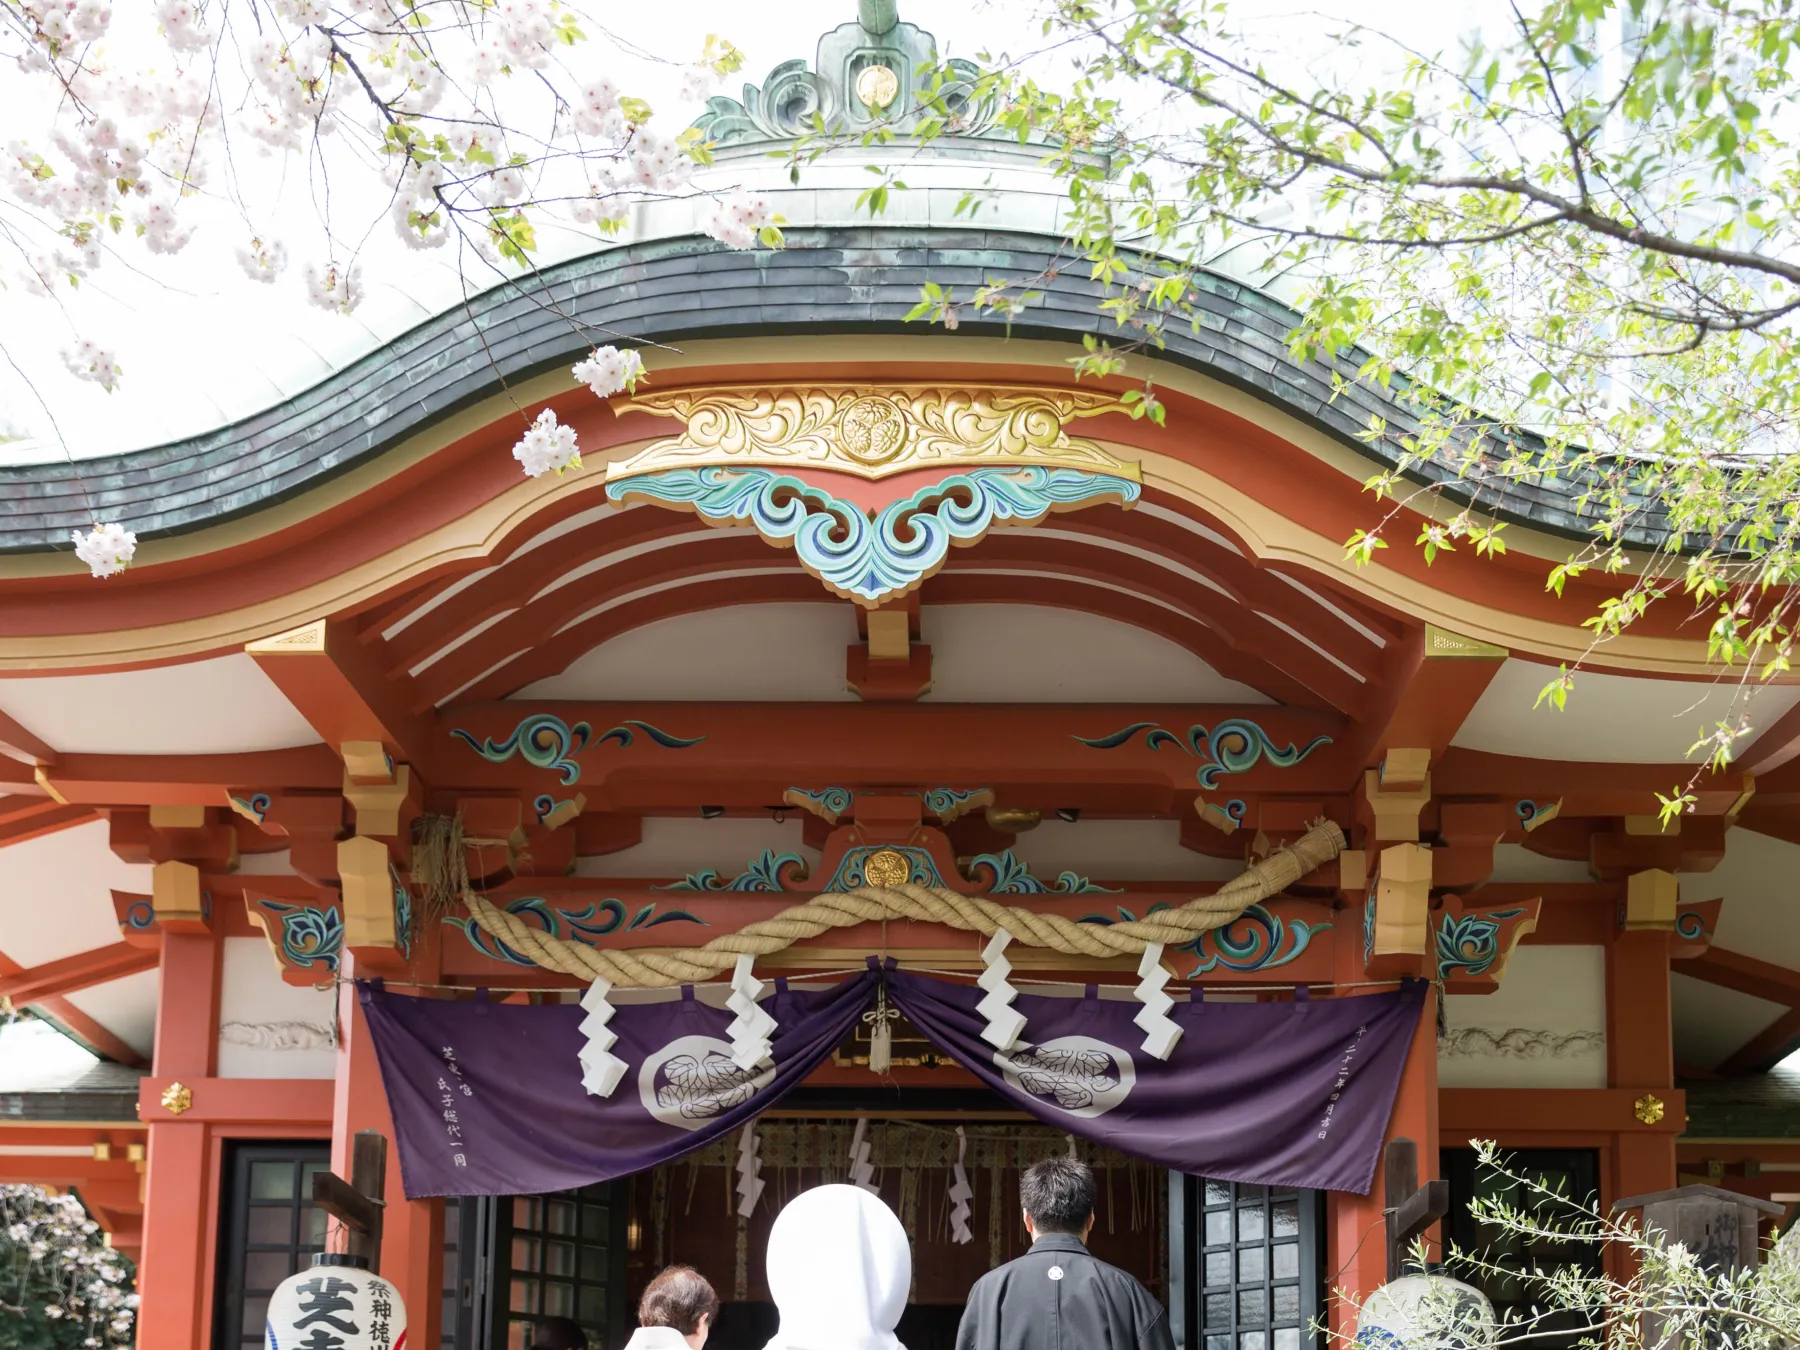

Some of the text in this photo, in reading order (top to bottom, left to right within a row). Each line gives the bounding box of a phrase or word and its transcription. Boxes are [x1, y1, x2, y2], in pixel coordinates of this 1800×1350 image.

[442, 1046, 473, 1096] 芝東宮
[1317, 1025, 1367, 1139] 平二十二年四月吉日
[437, 1077, 467, 1167] 氏子総代一同
